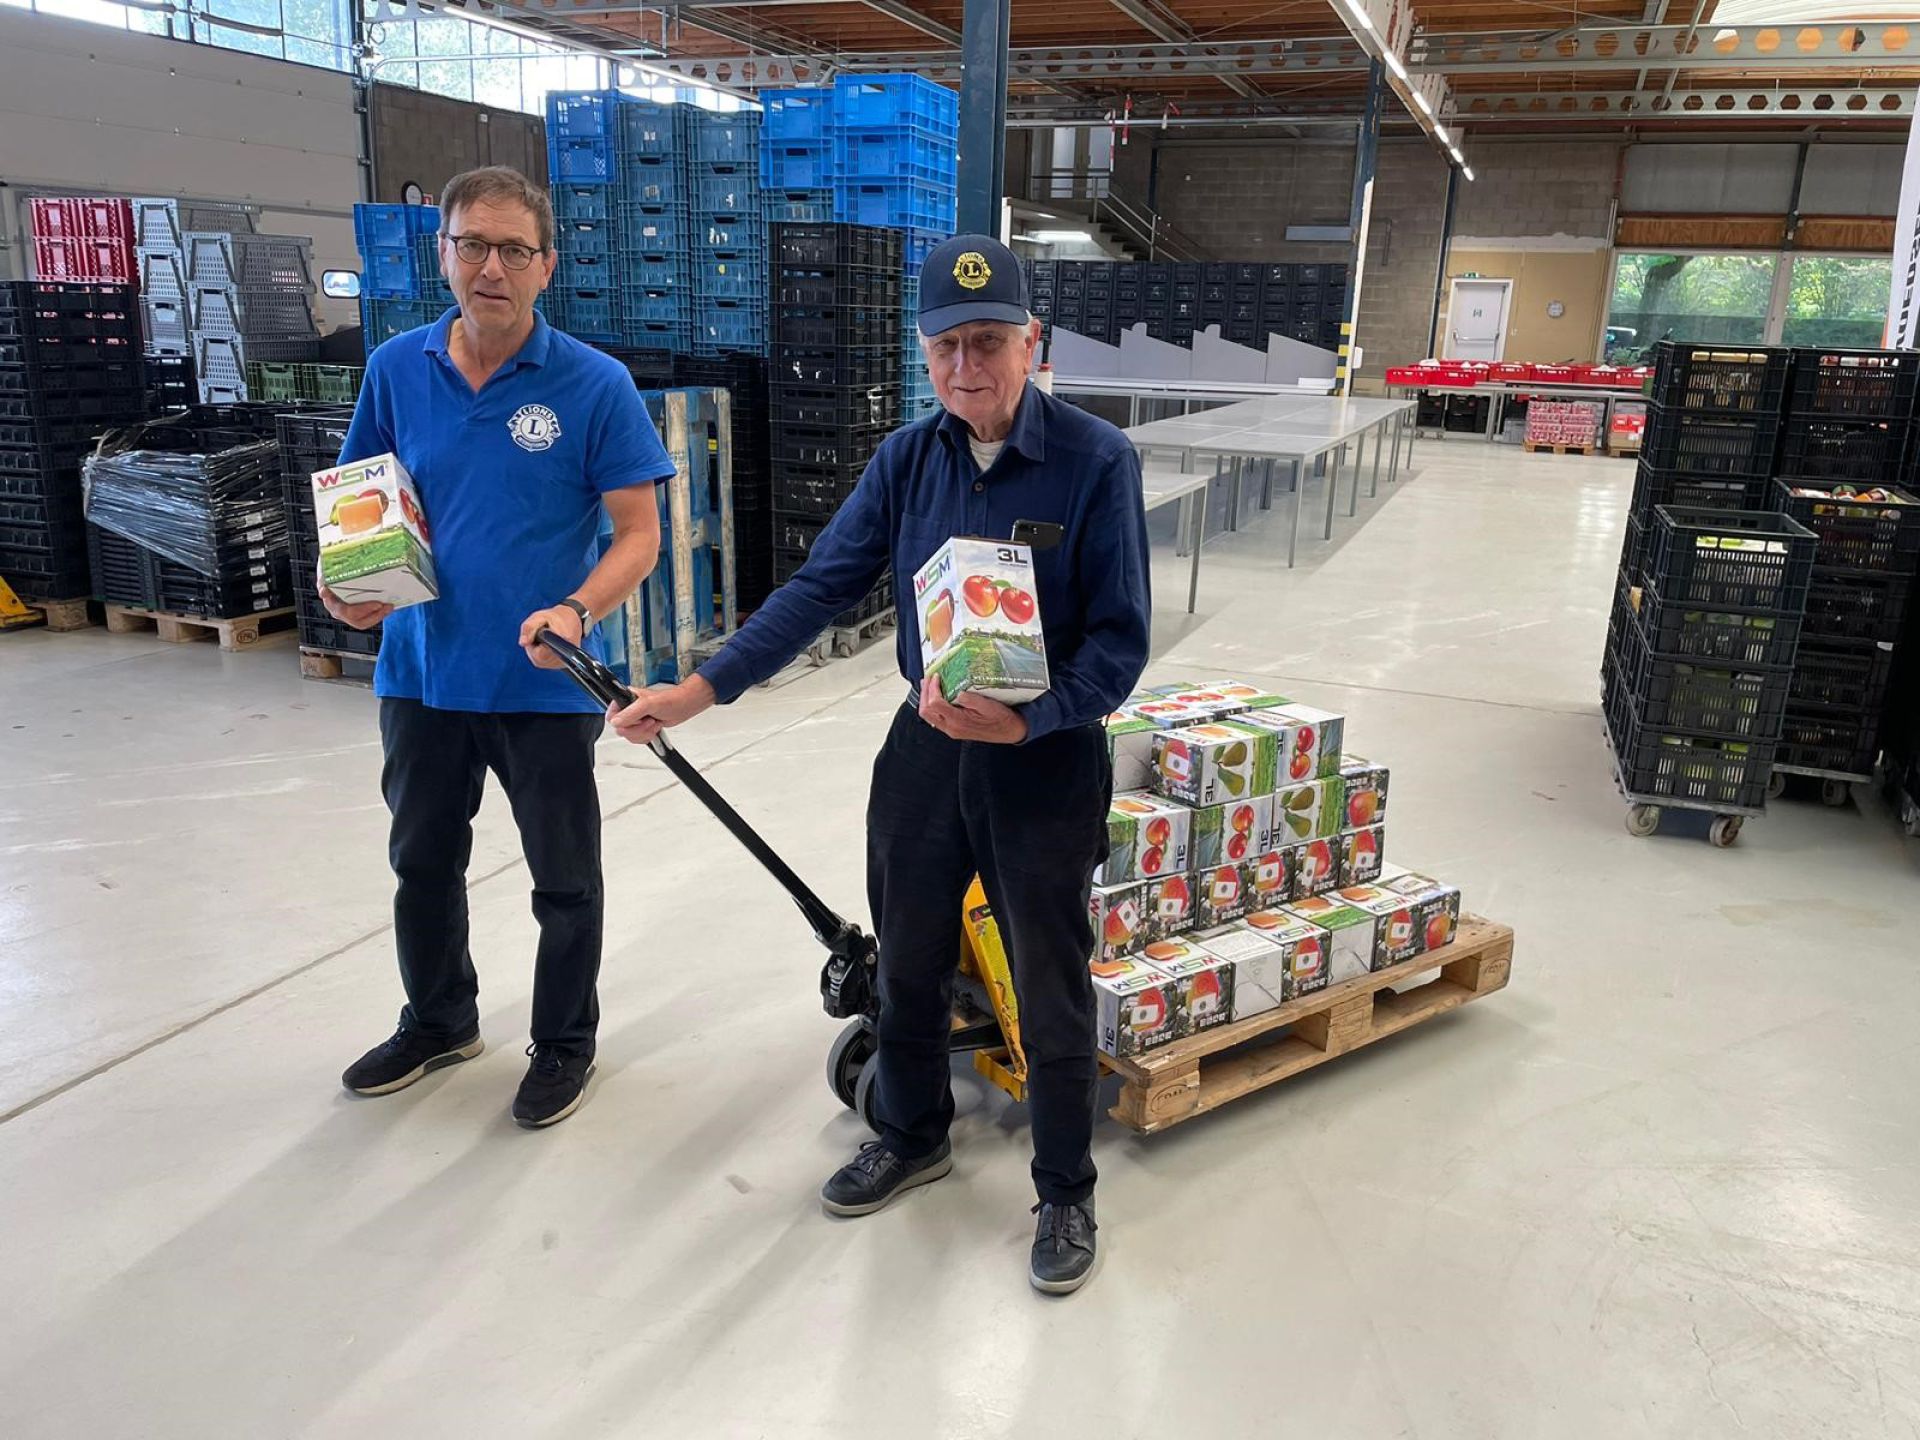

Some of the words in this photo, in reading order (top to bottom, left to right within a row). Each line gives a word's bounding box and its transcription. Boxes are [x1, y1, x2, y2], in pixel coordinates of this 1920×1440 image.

[521, 405, 553, 420] LIONS
[528, 419, 541, 436] L
[317, 460, 388, 492] WSM
[997, 548, 1027, 564] 3L
[916, 547, 950, 599] WSM
[1205, 778, 1214, 803] 3L
[1260, 829, 1268, 853] 3L
[1176, 844, 1185, 868] 3L
[1105, 1027, 1115, 1051] 3L
